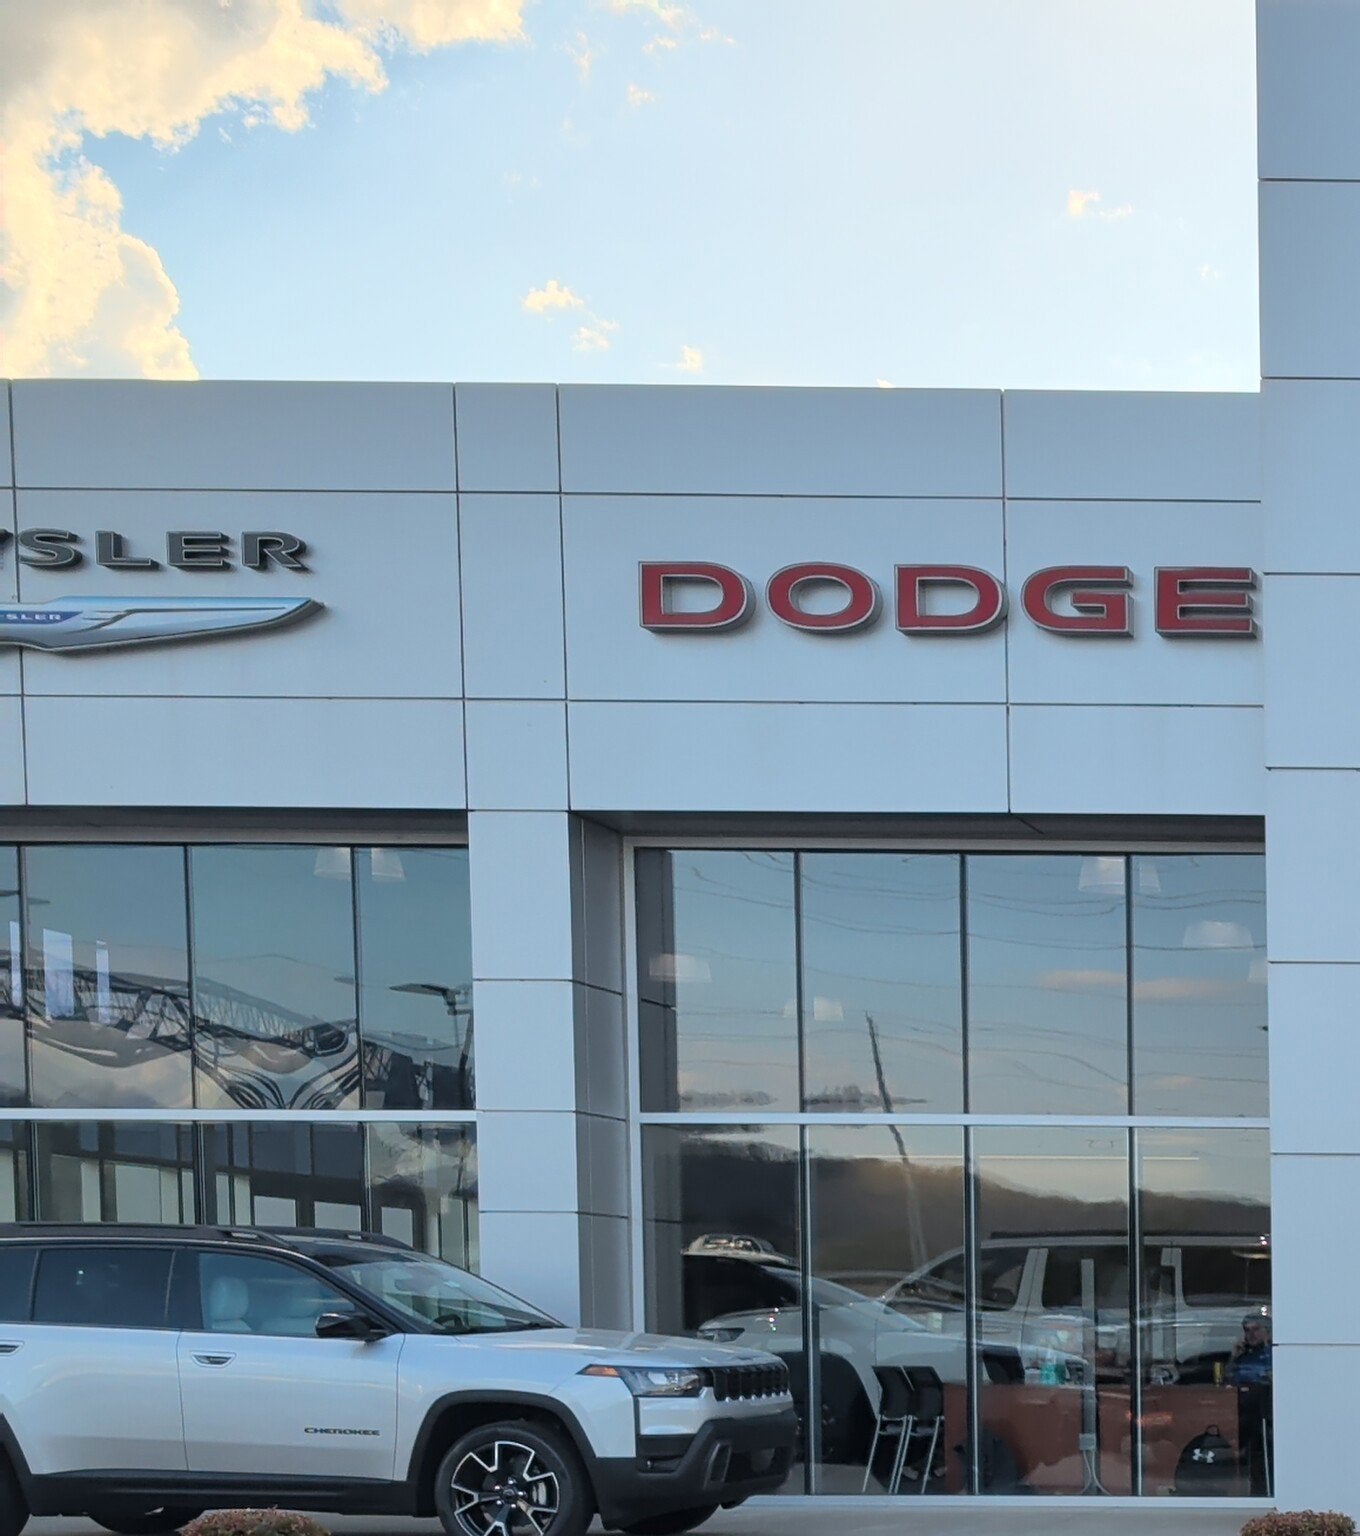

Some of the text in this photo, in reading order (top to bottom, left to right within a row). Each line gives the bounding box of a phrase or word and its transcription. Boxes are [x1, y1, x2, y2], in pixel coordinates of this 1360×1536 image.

[0, 528, 311, 571] SLER
[638, 561, 1261, 639] DODGE
[304, 1427, 380, 1436] CHEROKEE
